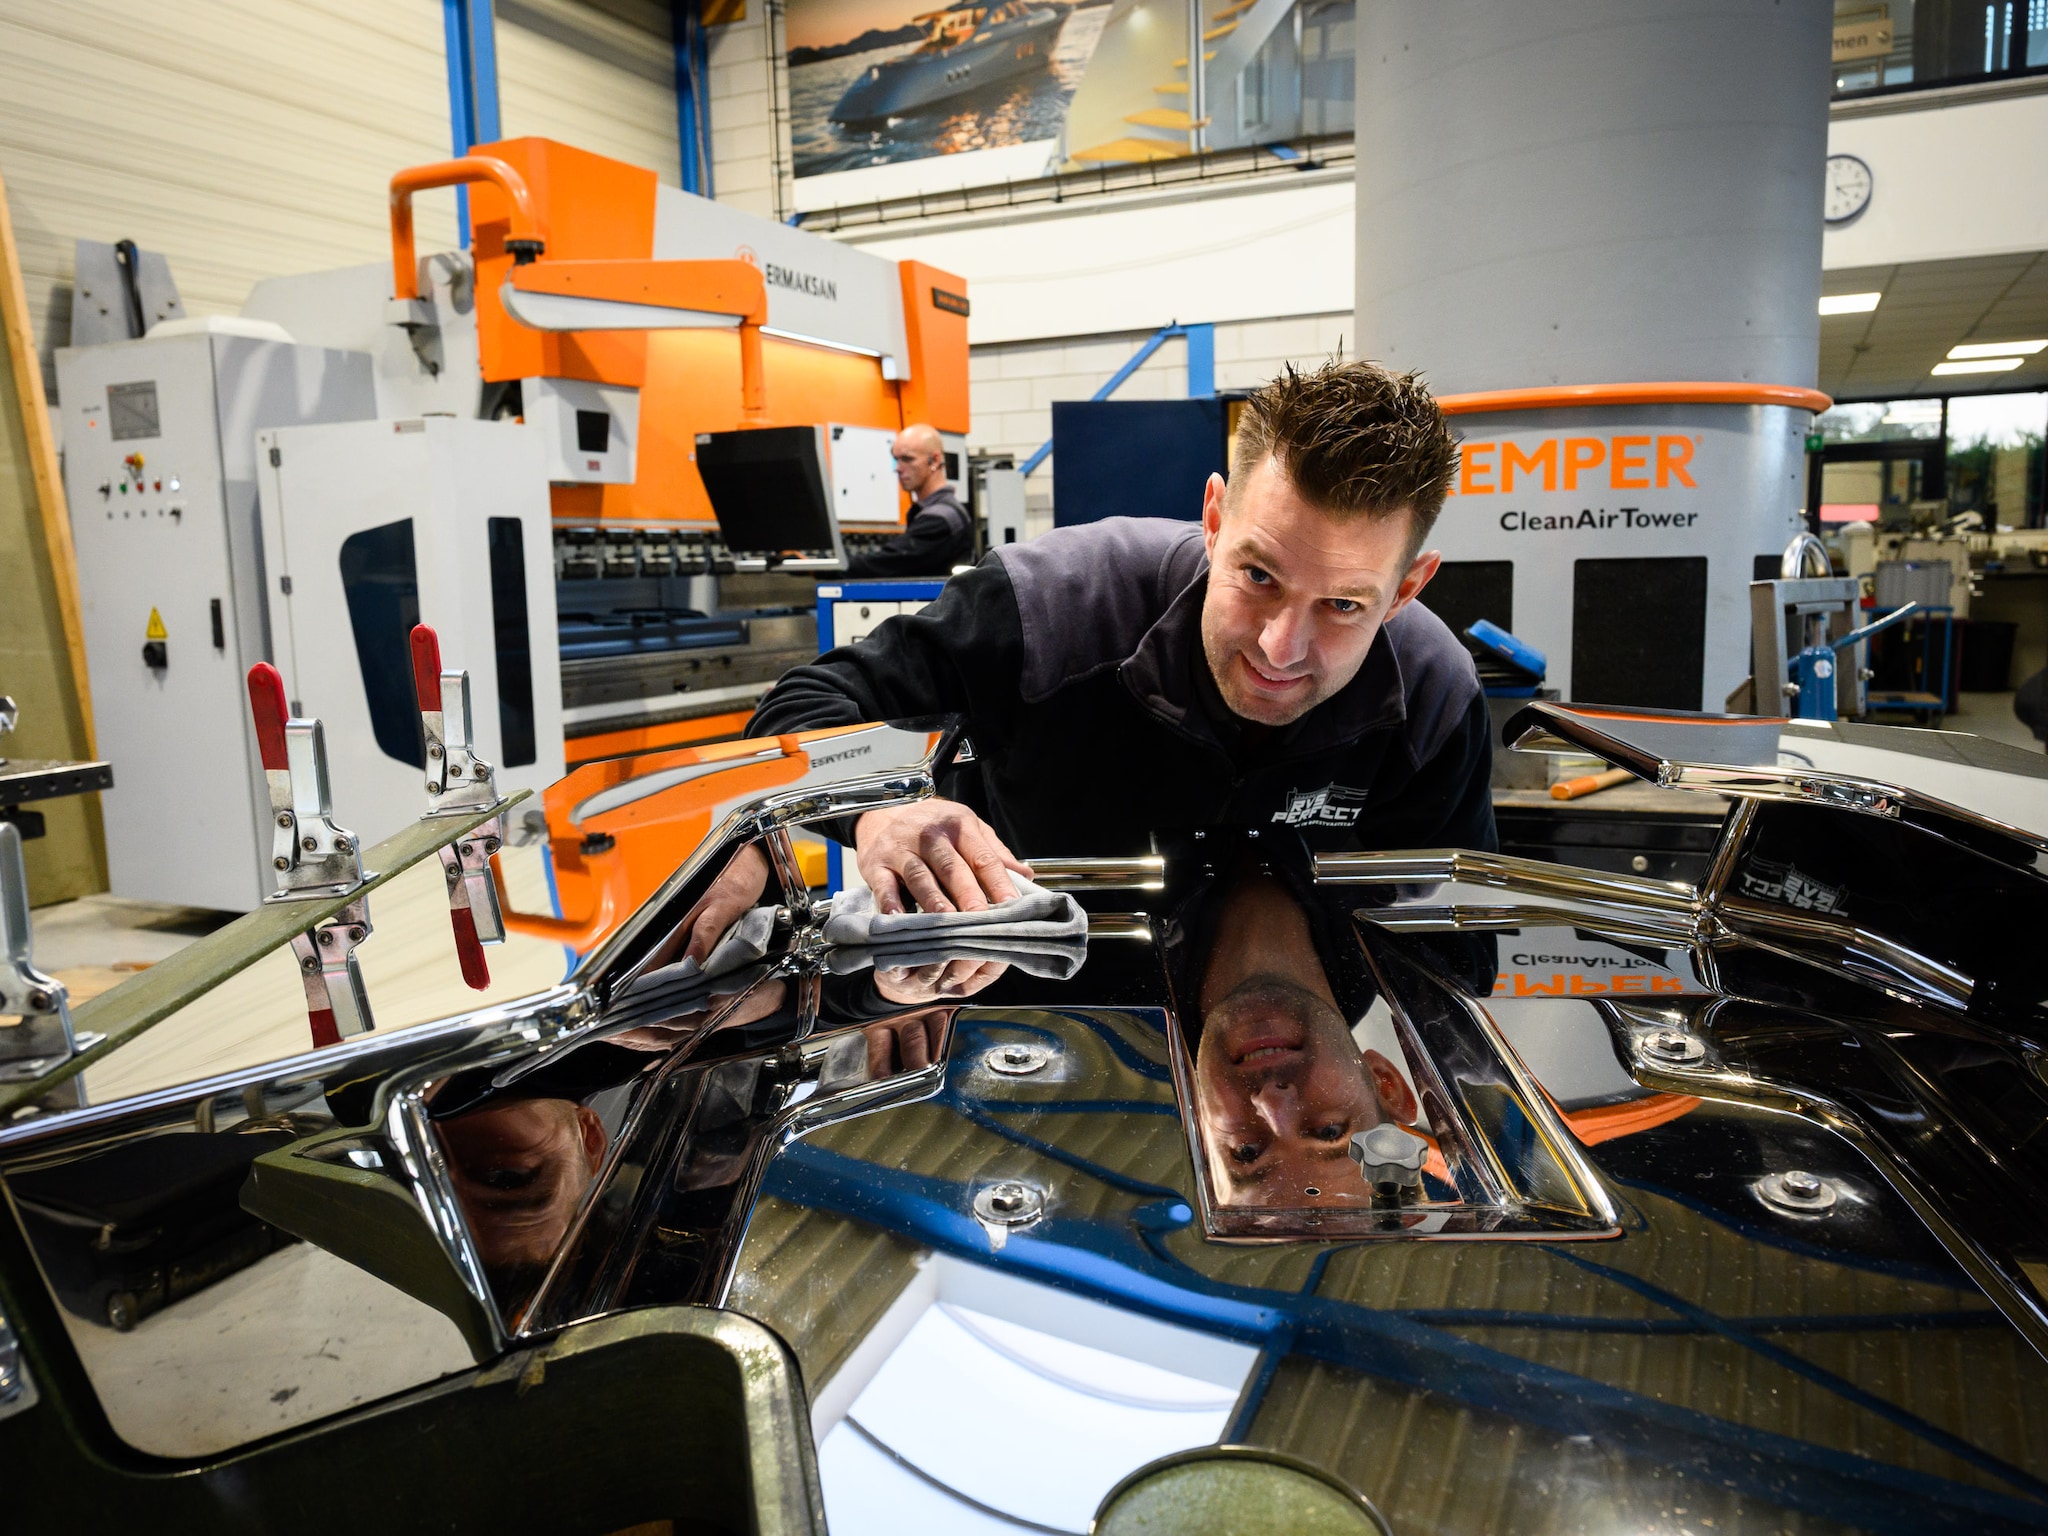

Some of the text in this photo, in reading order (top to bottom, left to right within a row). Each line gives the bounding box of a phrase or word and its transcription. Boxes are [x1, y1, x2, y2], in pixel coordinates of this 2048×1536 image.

[1834, 35, 1868, 50] men
[766, 263, 837, 301] ERMAKSAN
[1447, 434, 1698, 496] EMPER
[1500, 507, 1698, 532] CleanAirTower
[1270, 804, 1362, 824] PERFECT
[1291, 793, 1327, 813] RVS
